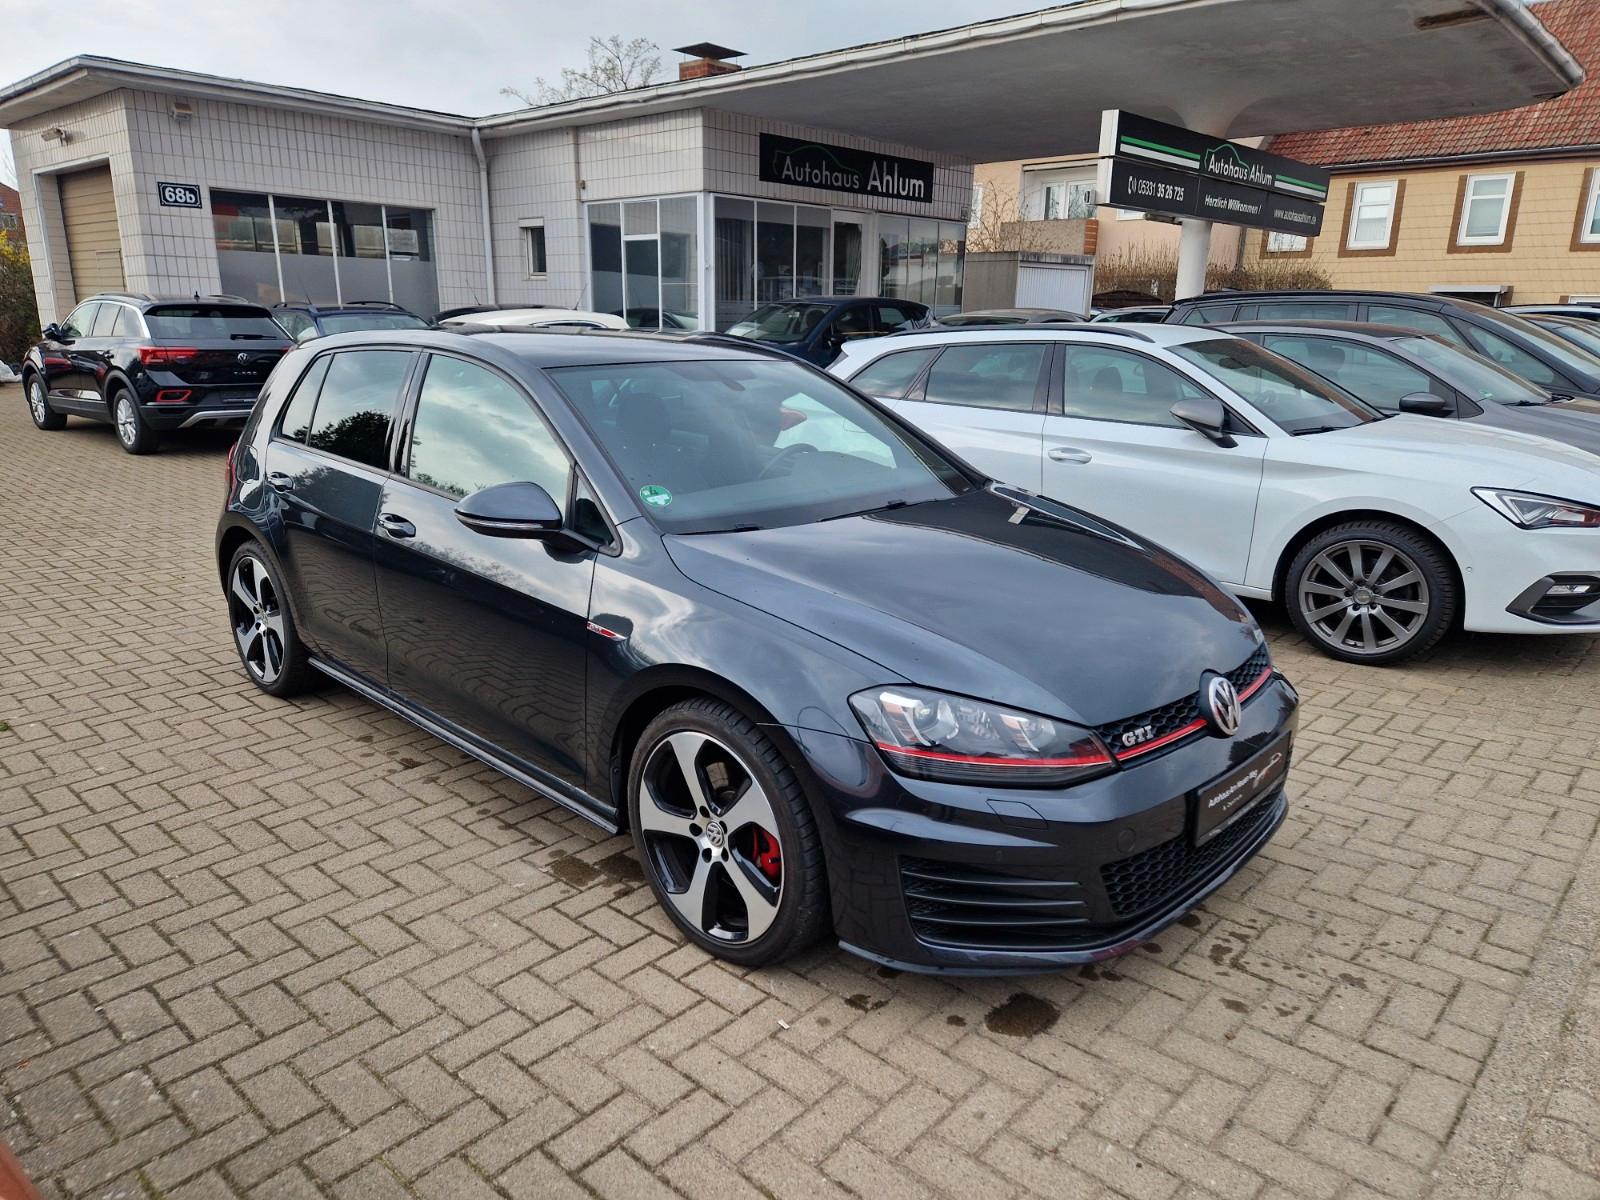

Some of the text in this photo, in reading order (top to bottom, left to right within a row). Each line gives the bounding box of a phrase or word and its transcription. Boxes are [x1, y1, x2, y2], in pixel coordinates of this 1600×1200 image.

[781, 155, 925, 199] Autohaus Ahlum
[1208, 153, 1273, 186] Autohaus Ahlum
[164, 187, 196, 204] 68b
[1156, 182, 1165, 198] 35
[1165, 184, 1173, 199] 26
[1173, 186, 1185, 202] 725
[1205, 194, 1228, 209] Herzlich
[1122, 725, 1154, 747] GTI
